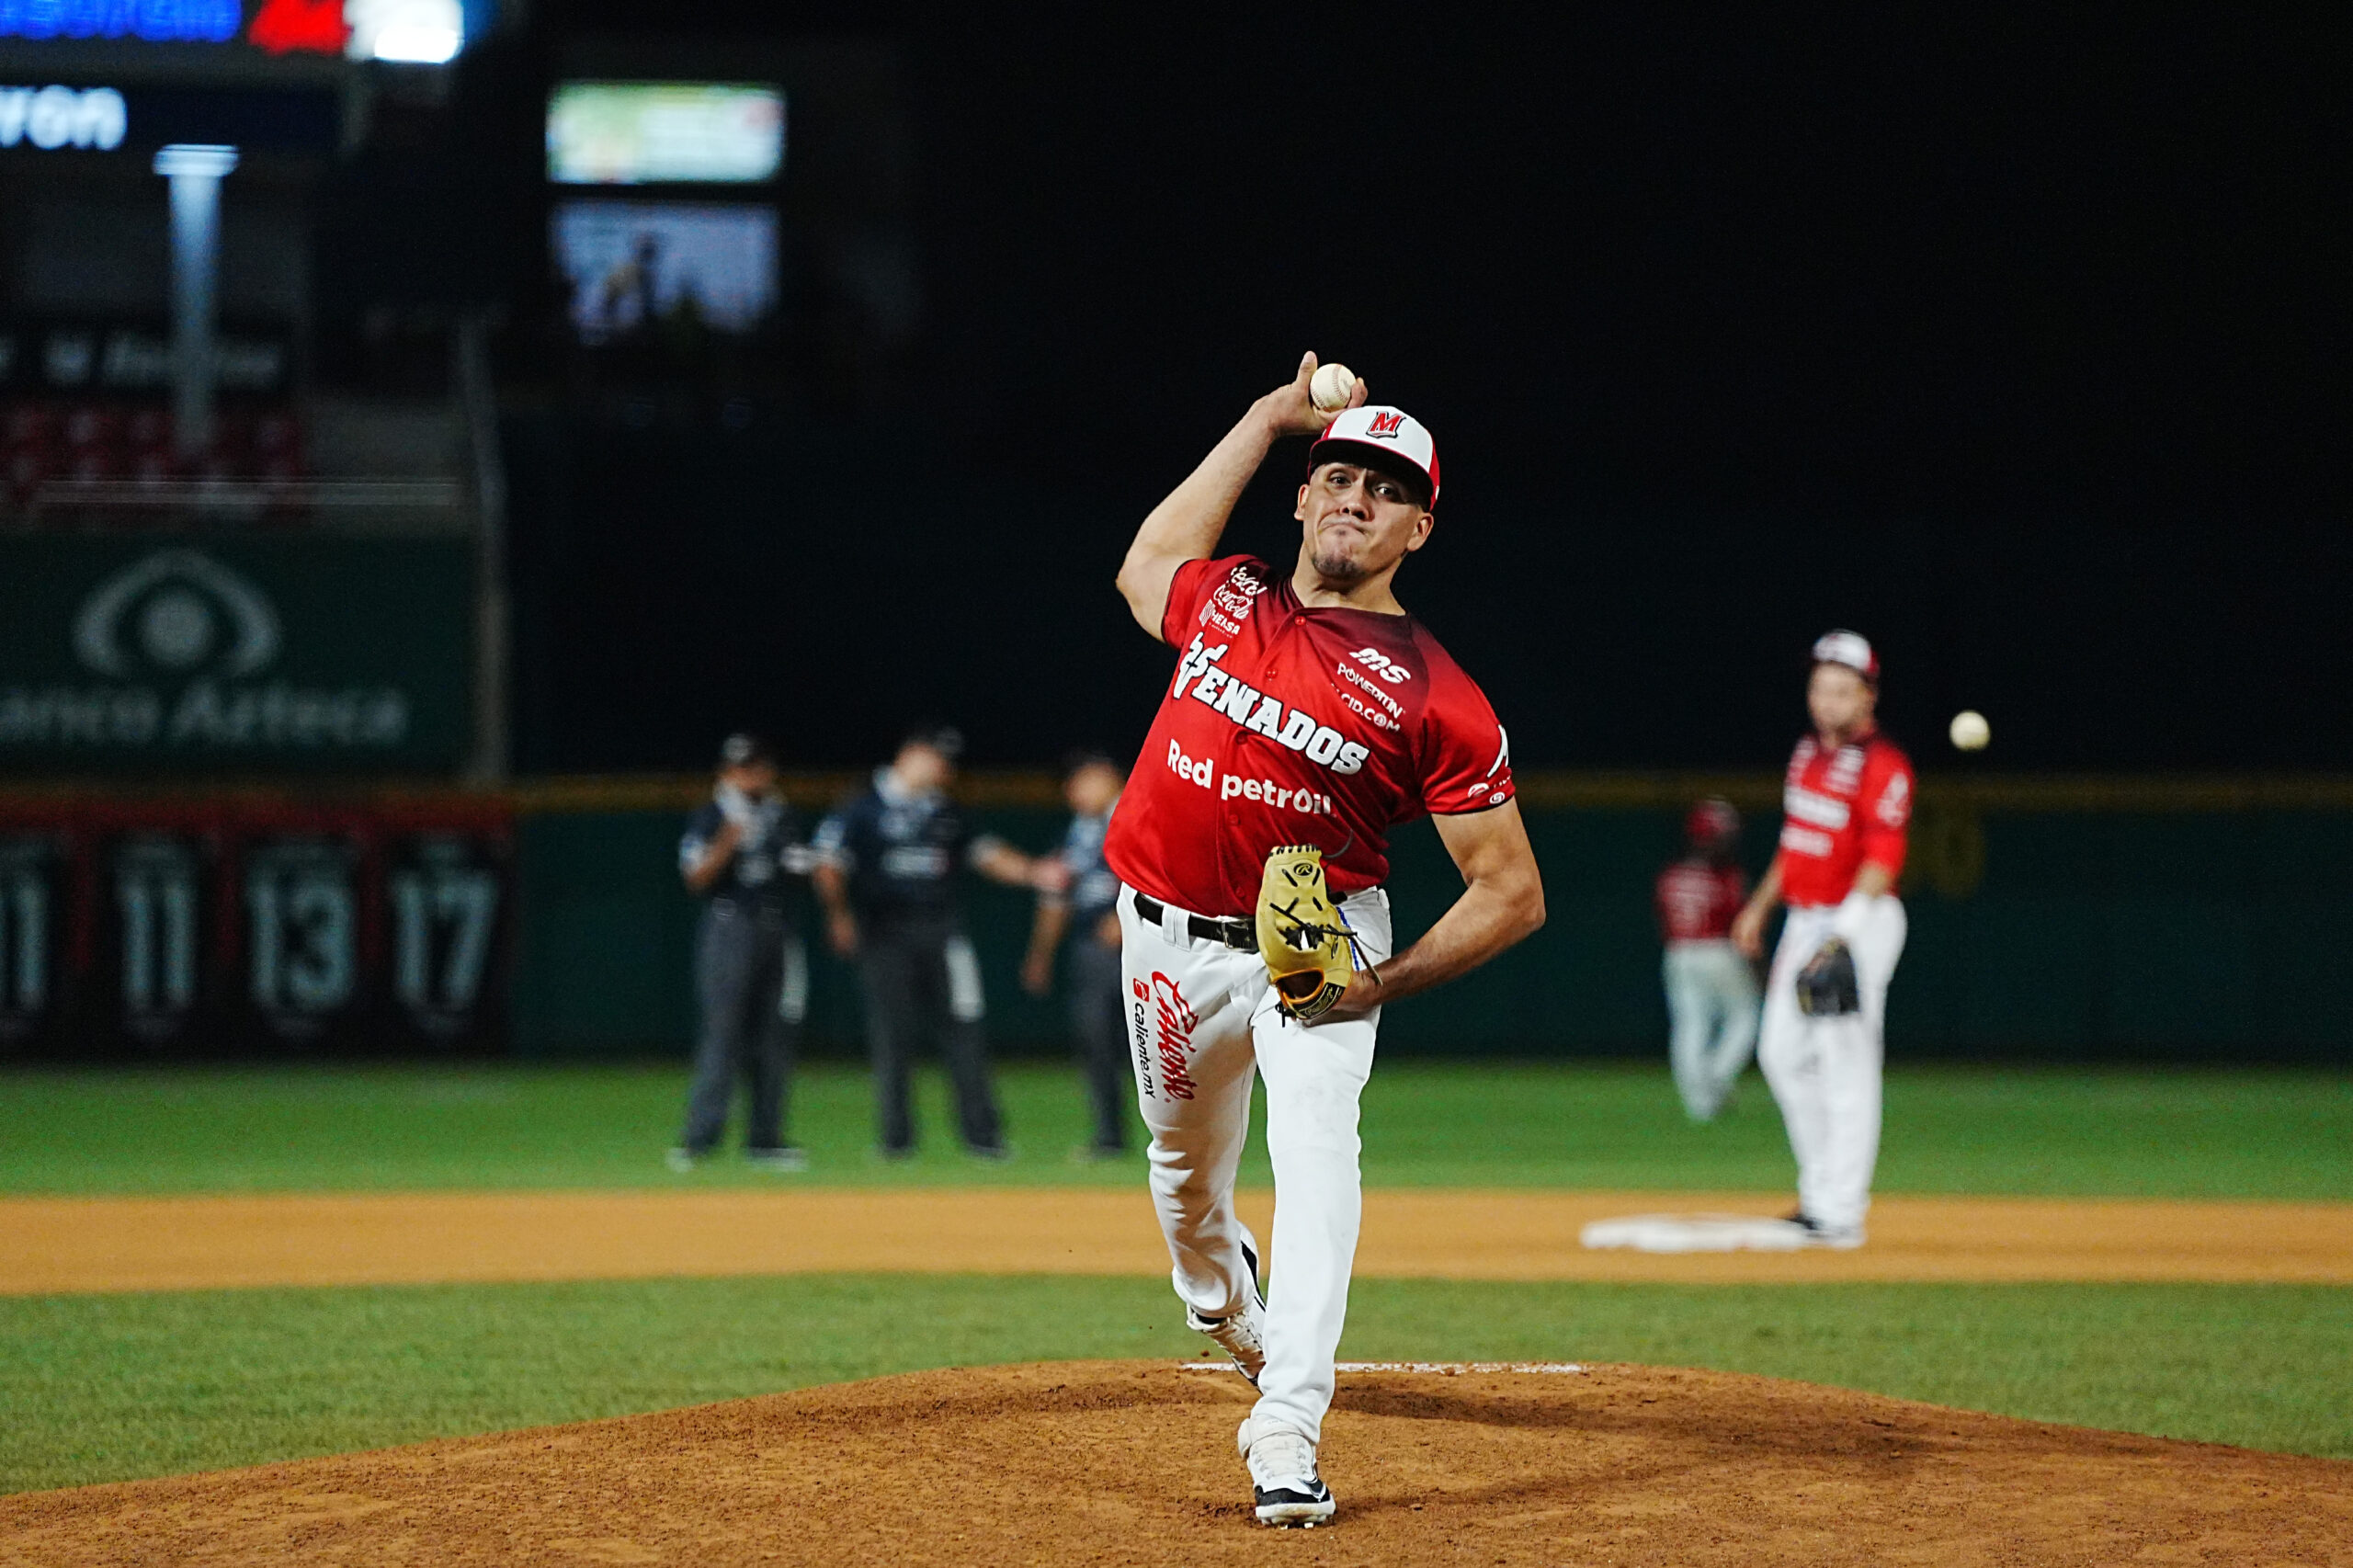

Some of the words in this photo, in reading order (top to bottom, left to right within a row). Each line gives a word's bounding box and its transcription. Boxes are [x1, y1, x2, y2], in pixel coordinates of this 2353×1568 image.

[1368, 412, 1405, 437] M
[0, 684, 159, 739] anco
[1173, 631, 1370, 775] VENADOS
[1331, 683, 1401, 732] CID.COM
[1167, 738, 1213, 790] Red
[121, 876, 193, 1004] 11
[248, 876, 355, 1007] 13
[392, 869, 498, 1006] 17
[1134, 1001, 1155, 1099] caliente.mx
[1151, 971, 1199, 1100] Caliente
